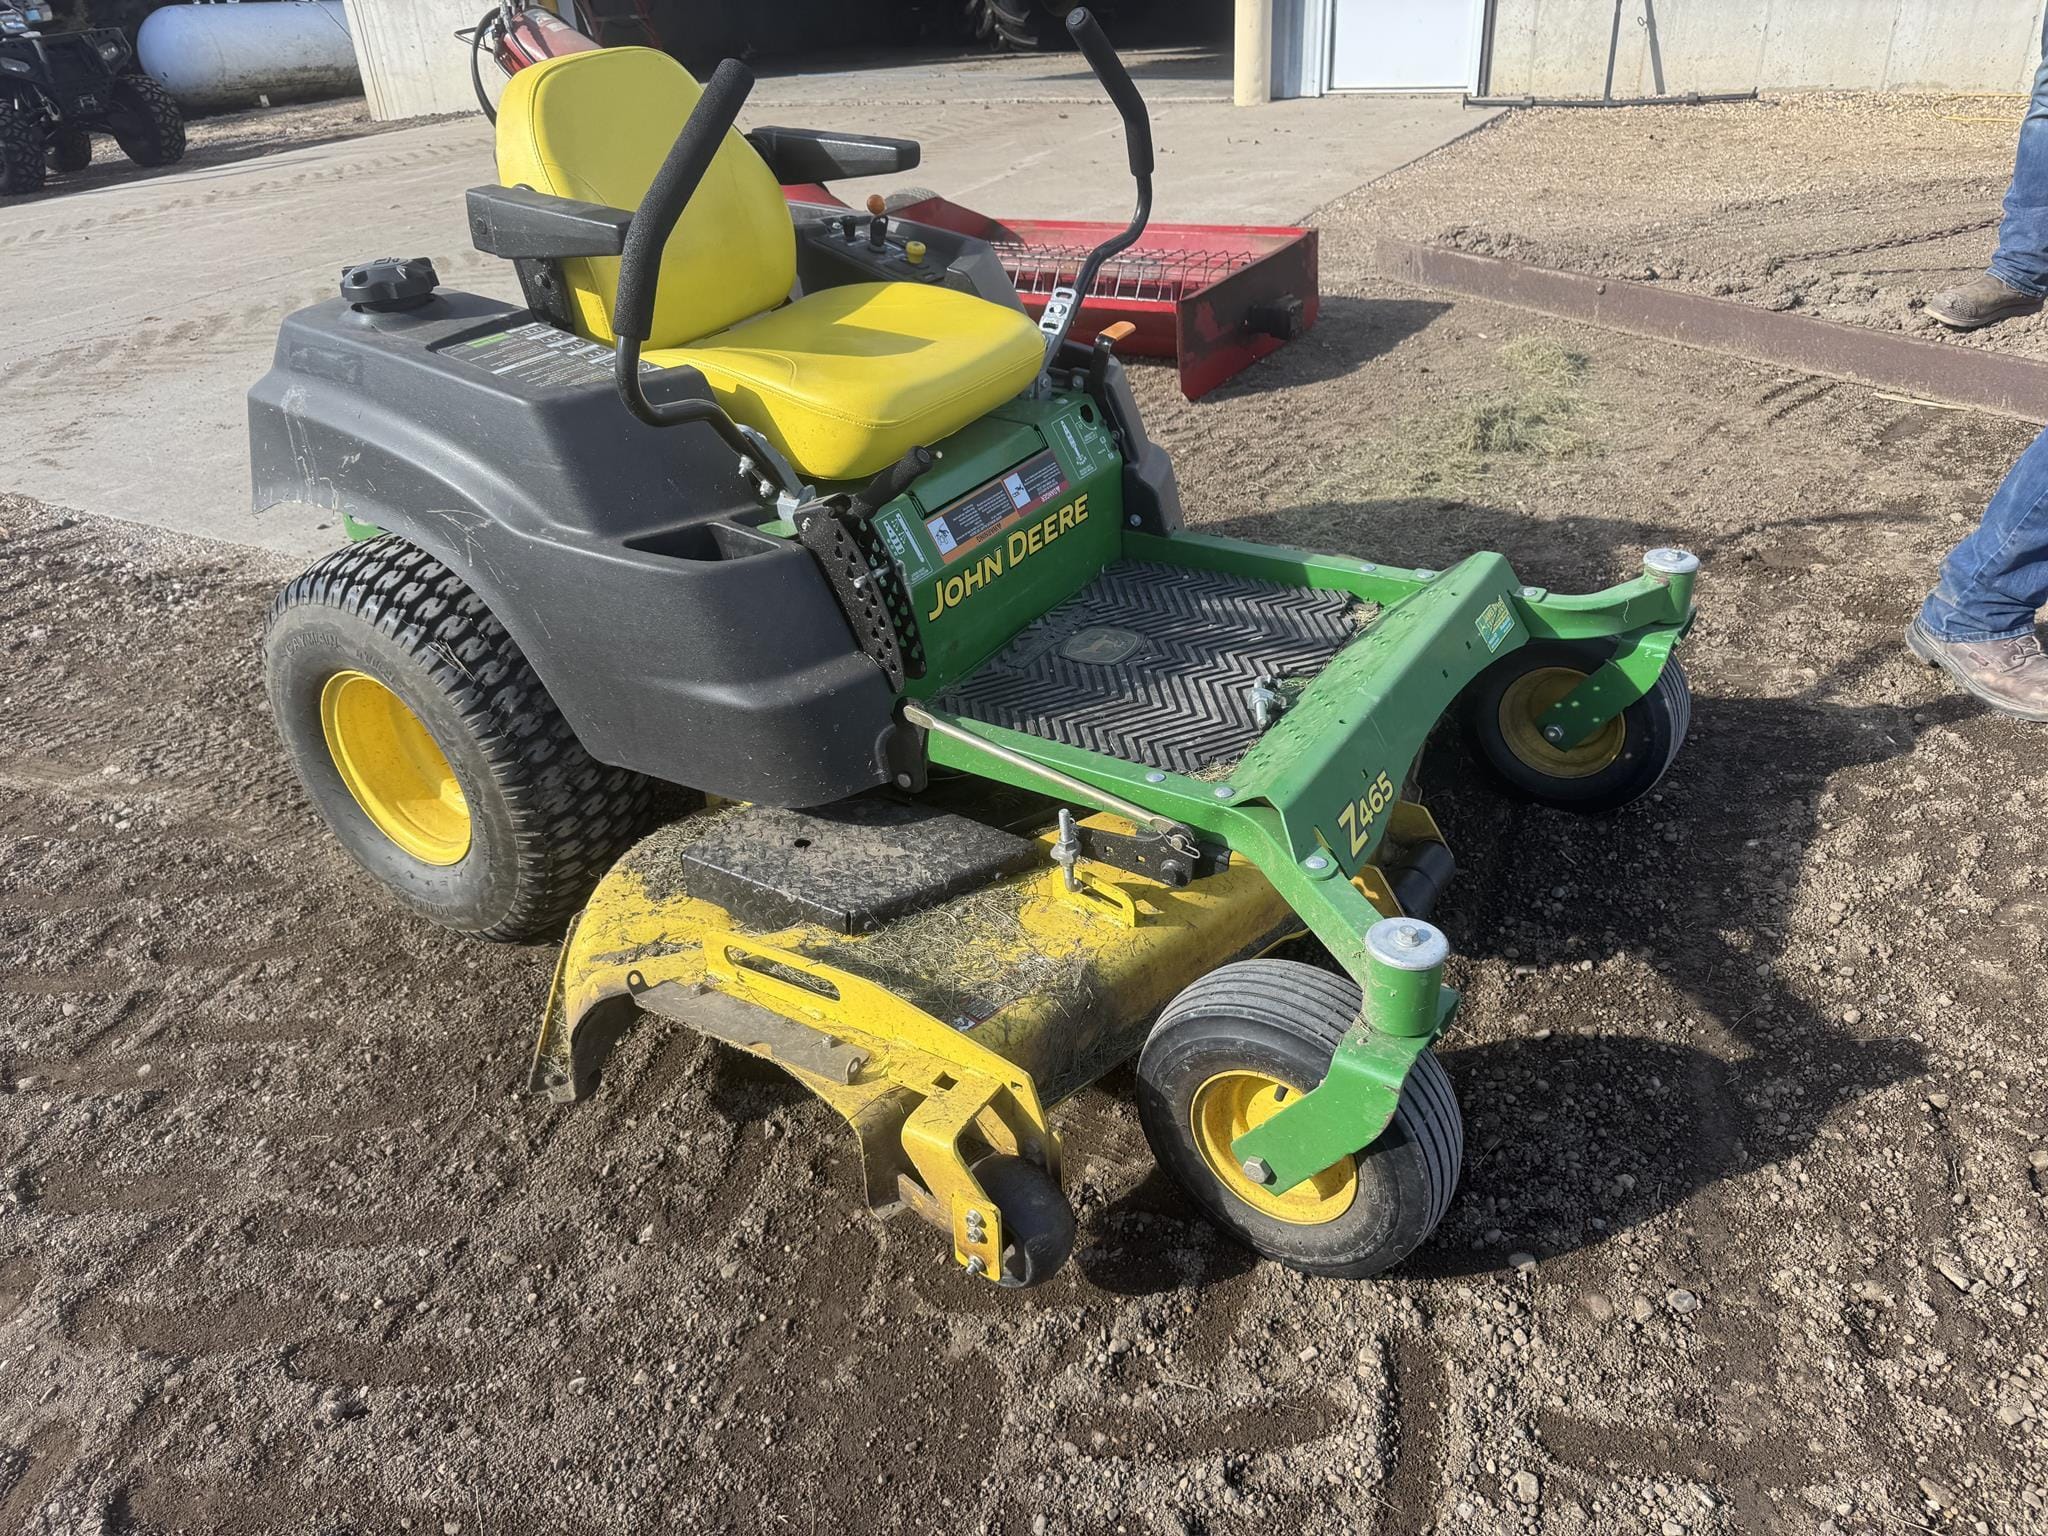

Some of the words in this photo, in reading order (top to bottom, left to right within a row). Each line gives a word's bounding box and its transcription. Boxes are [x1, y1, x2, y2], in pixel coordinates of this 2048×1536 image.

[928, 547, 1003, 621] JOHN
[1008, 492, 1089, 568] DEERE
[1337, 769, 1394, 858] Z465
